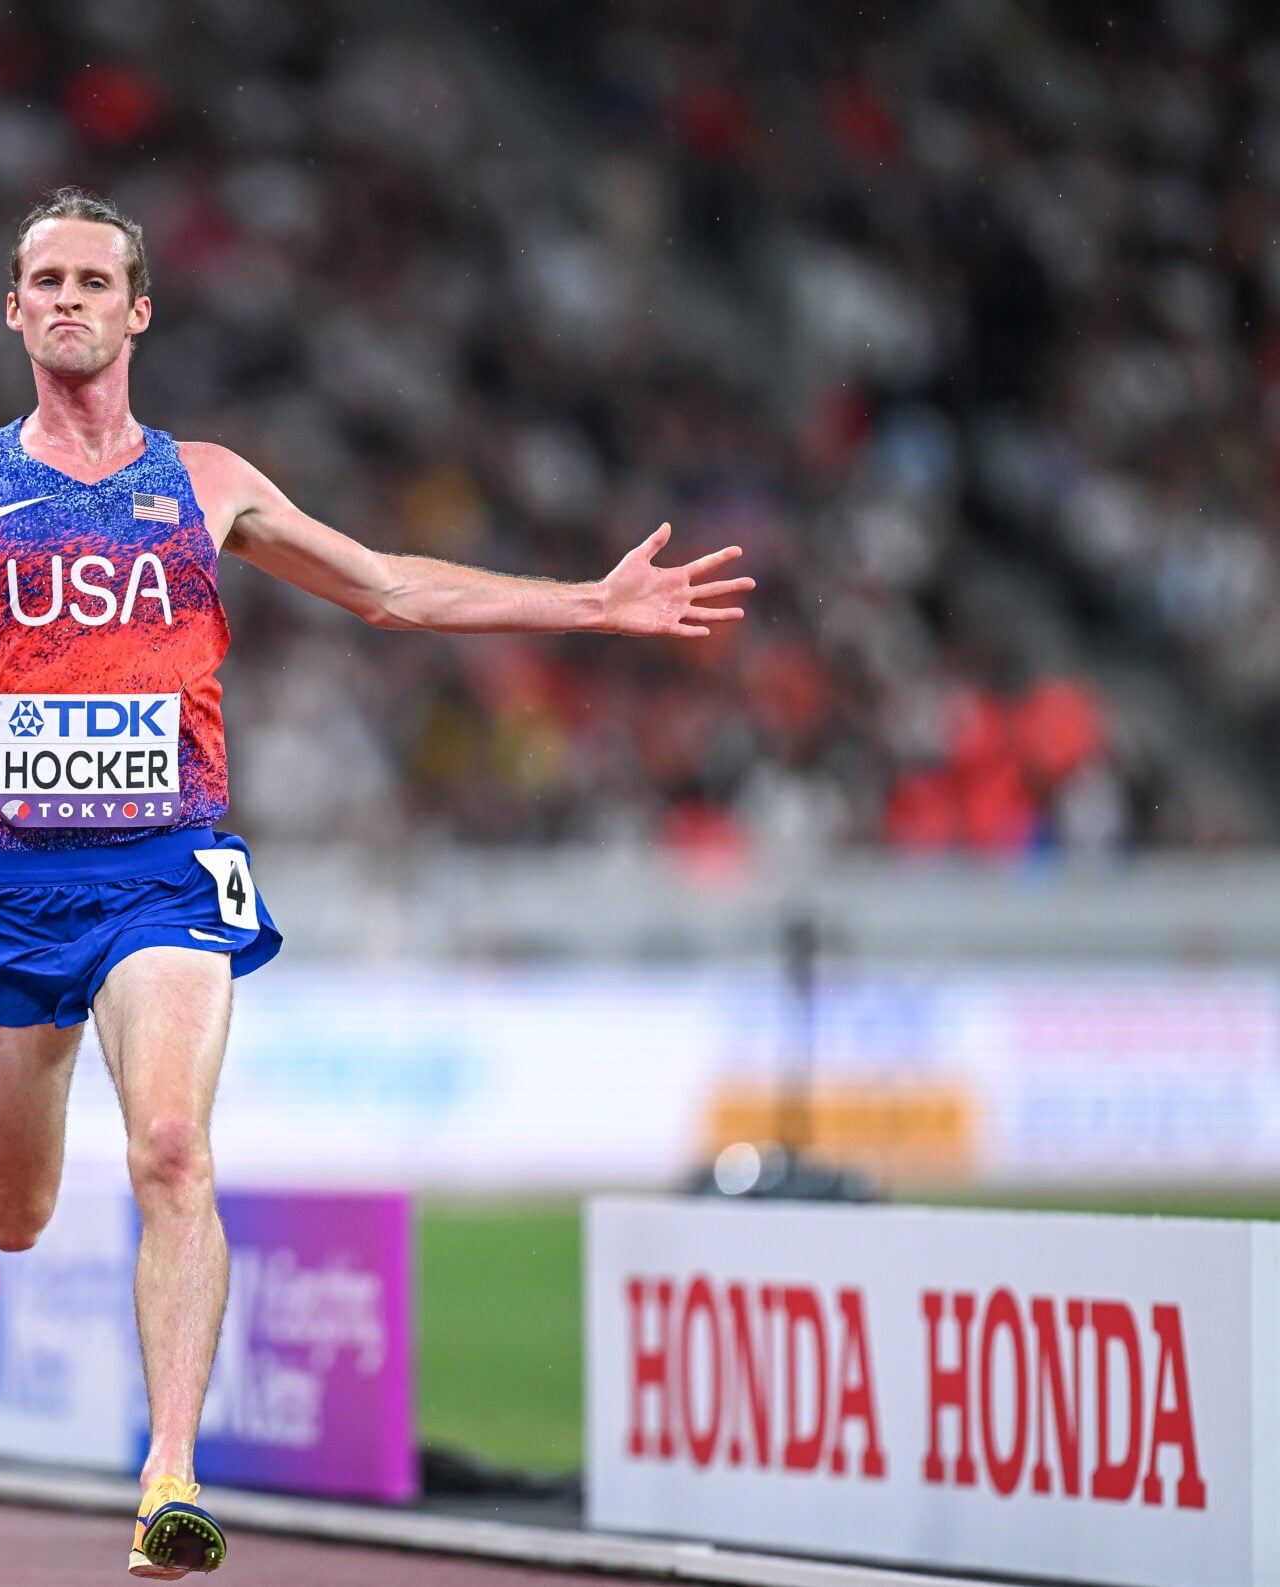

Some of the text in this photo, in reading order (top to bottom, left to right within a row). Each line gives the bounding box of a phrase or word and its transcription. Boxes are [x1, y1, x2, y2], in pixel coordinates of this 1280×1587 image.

[7, 552, 173, 627] USA
[43, 700, 168, 737] TDK
[4, 750, 169, 790] HOCKER
[227, 860, 246, 916] 4
[626, 1270, 887, 1480] HONDA
[921, 1285, 1208, 1512] HONDA
